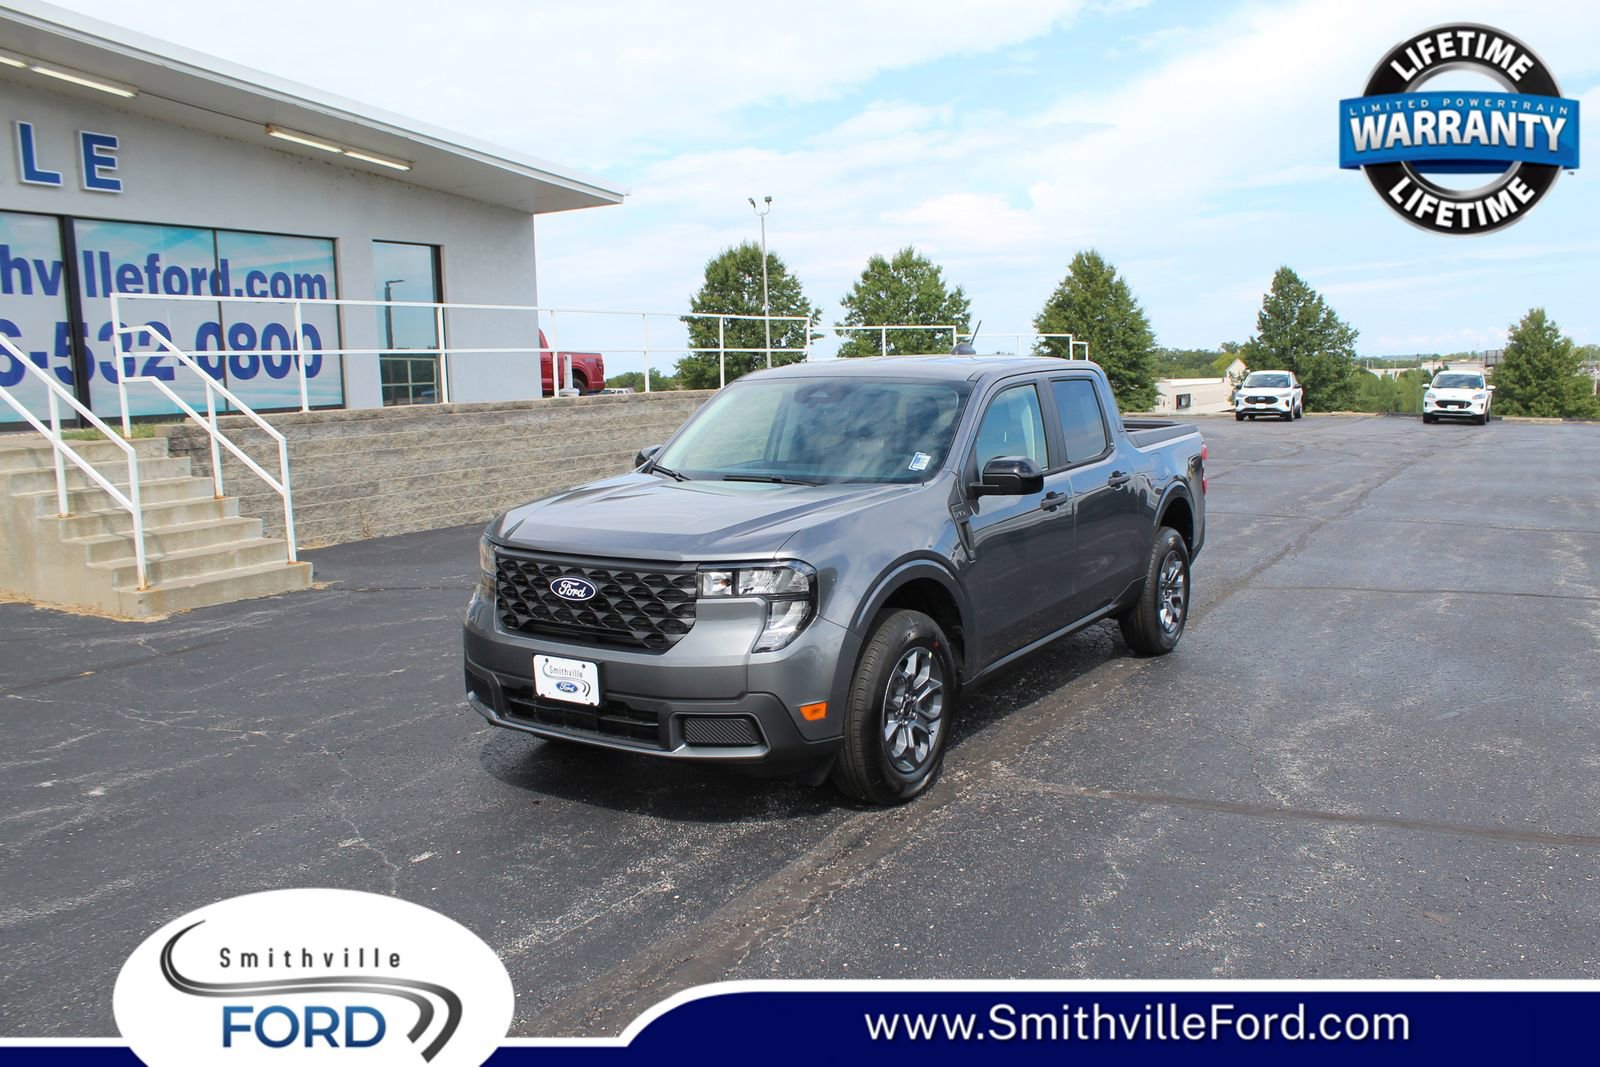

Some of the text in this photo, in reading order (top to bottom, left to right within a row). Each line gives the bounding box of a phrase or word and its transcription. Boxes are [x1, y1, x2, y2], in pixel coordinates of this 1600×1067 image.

[0, 244, 327, 299] hvlleford.com
[558, 580, 587, 598] Ford
[549, 665, 584, 679] Smithville
[559, 682, 577, 693] Ford
